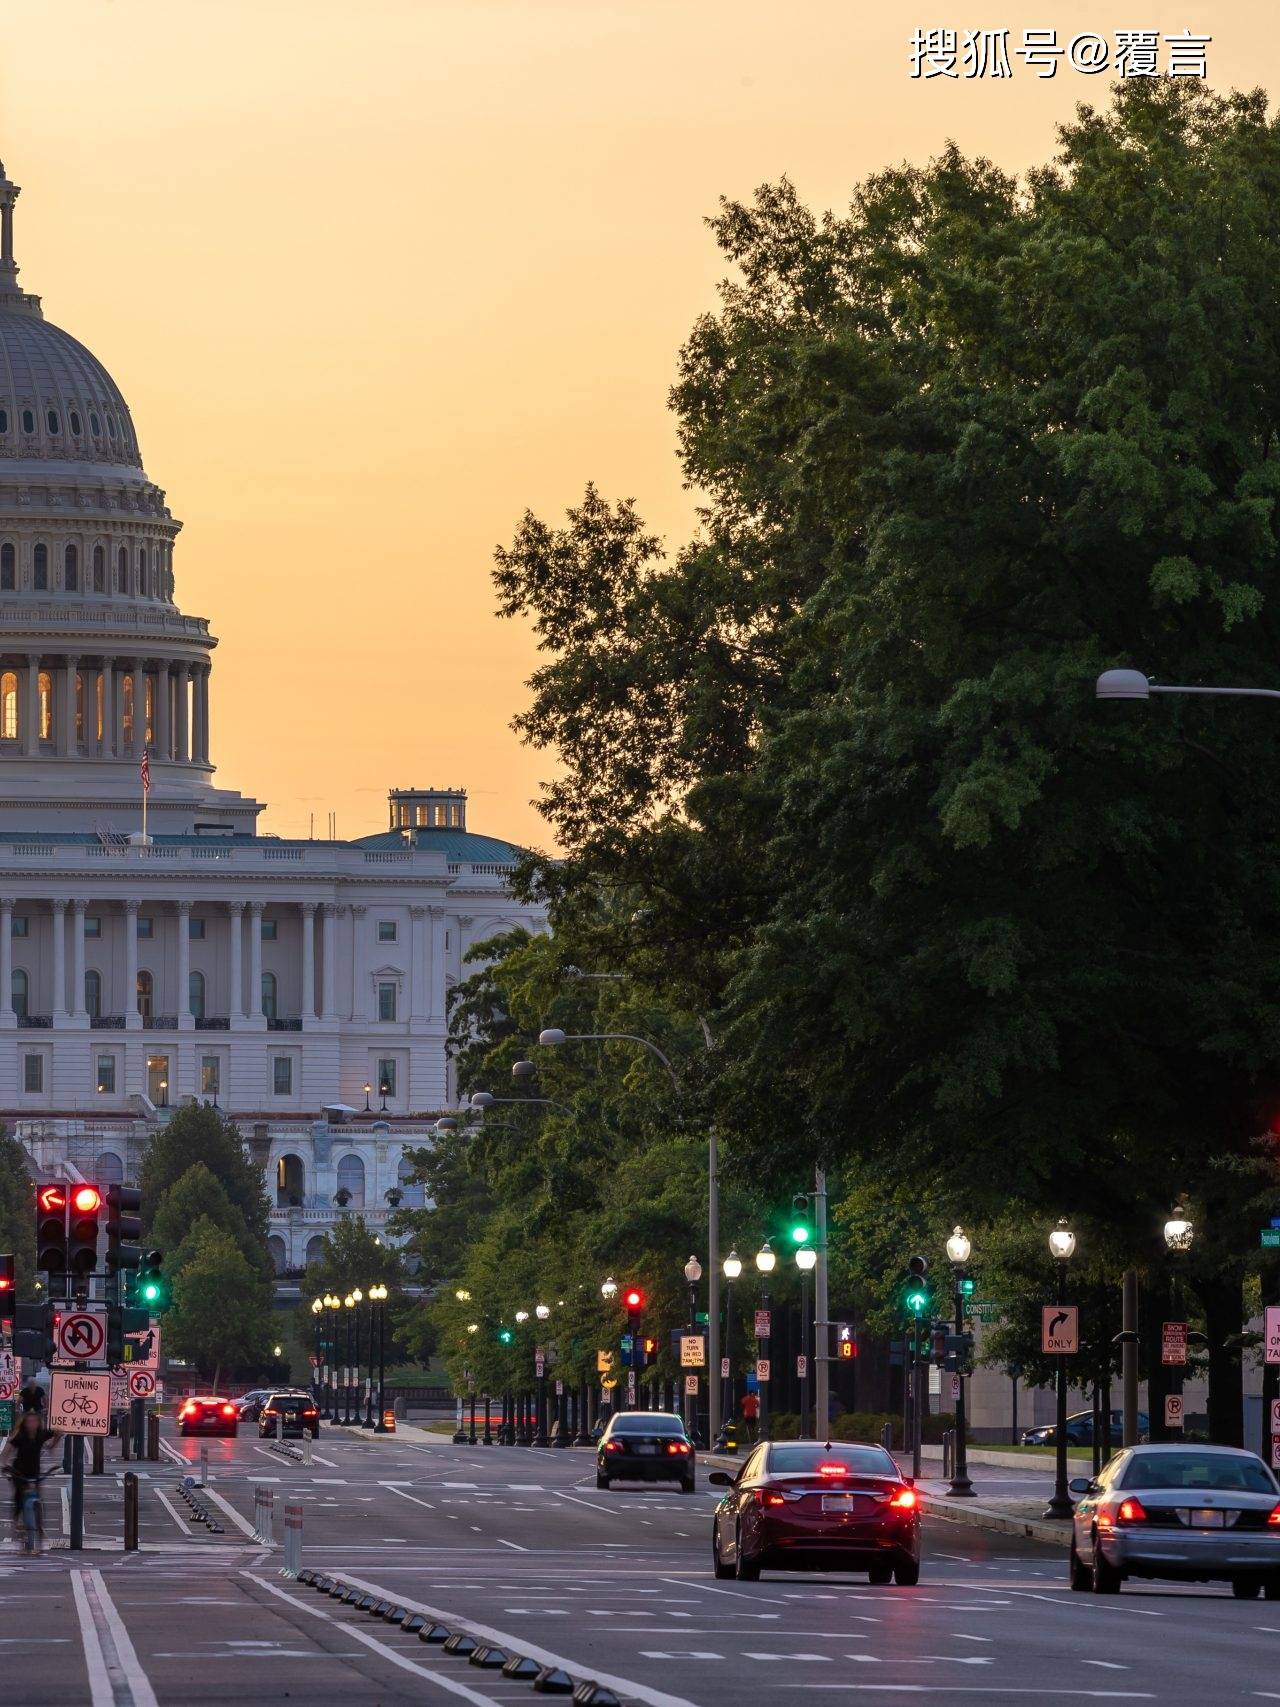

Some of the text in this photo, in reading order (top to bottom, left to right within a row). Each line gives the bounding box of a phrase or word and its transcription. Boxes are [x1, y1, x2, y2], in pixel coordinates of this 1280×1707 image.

[1048, 1340, 1072, 1348] ONLY
[64, 1380, 99, 1391] TURNING
[51, 1416, 107, 1428] USE X-WALKS
